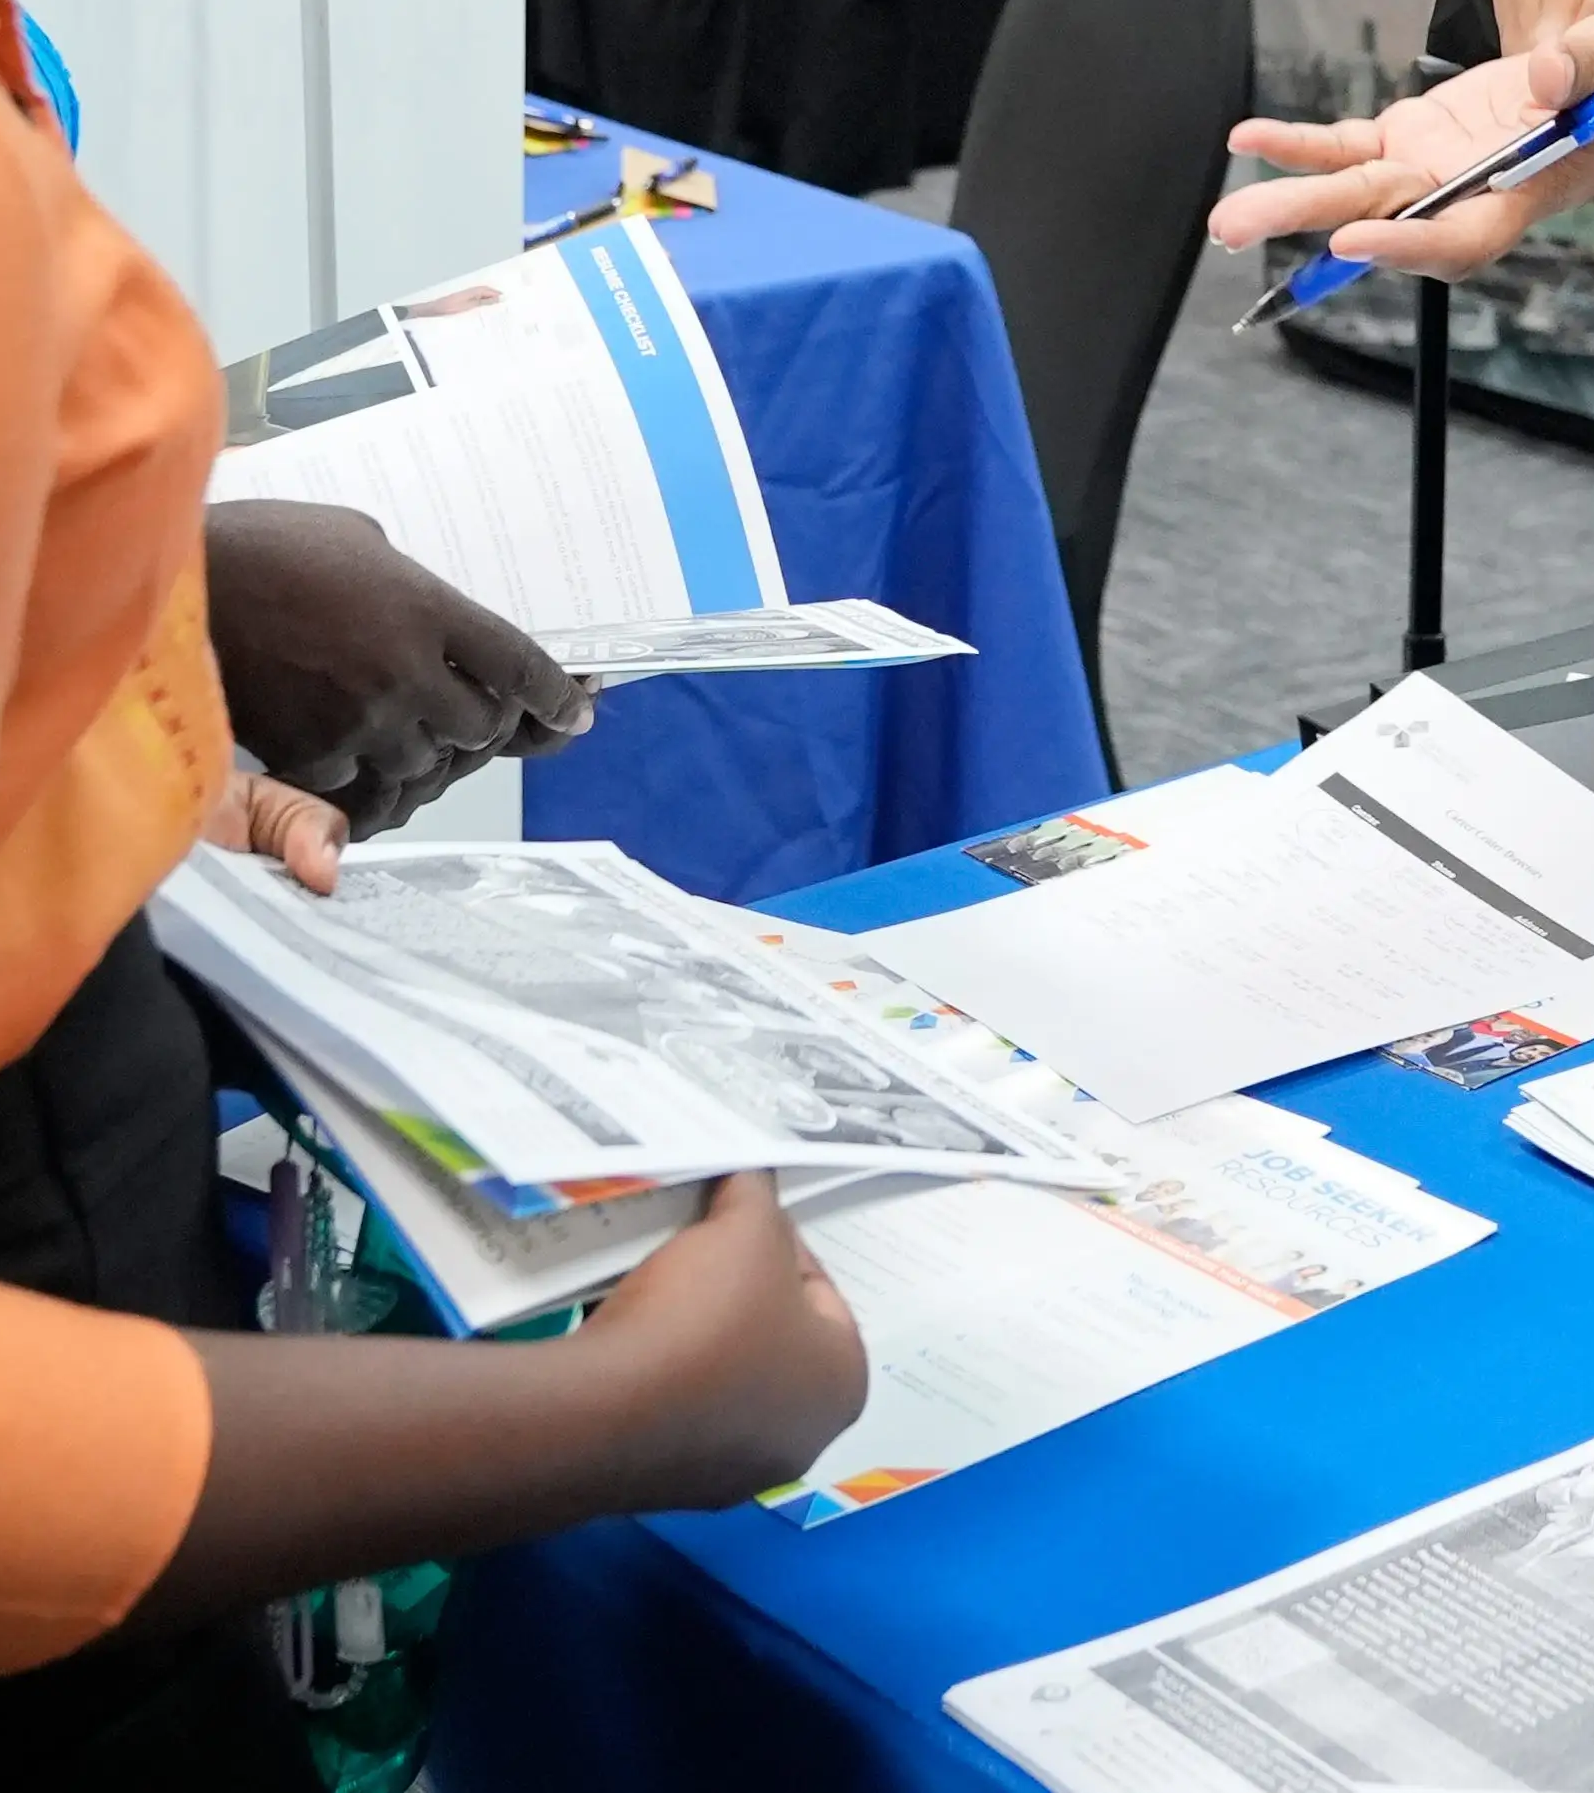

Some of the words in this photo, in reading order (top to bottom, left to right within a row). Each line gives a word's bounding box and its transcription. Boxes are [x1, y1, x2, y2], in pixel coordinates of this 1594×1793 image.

[613, 288, 658, 357] CHECKLIST
[1212, 1159, 1392, 1248] RESOURCES
[1241, 1149, 1315, 1182] JOB
[1312, 1180, 1437, 1244] SEEKER
